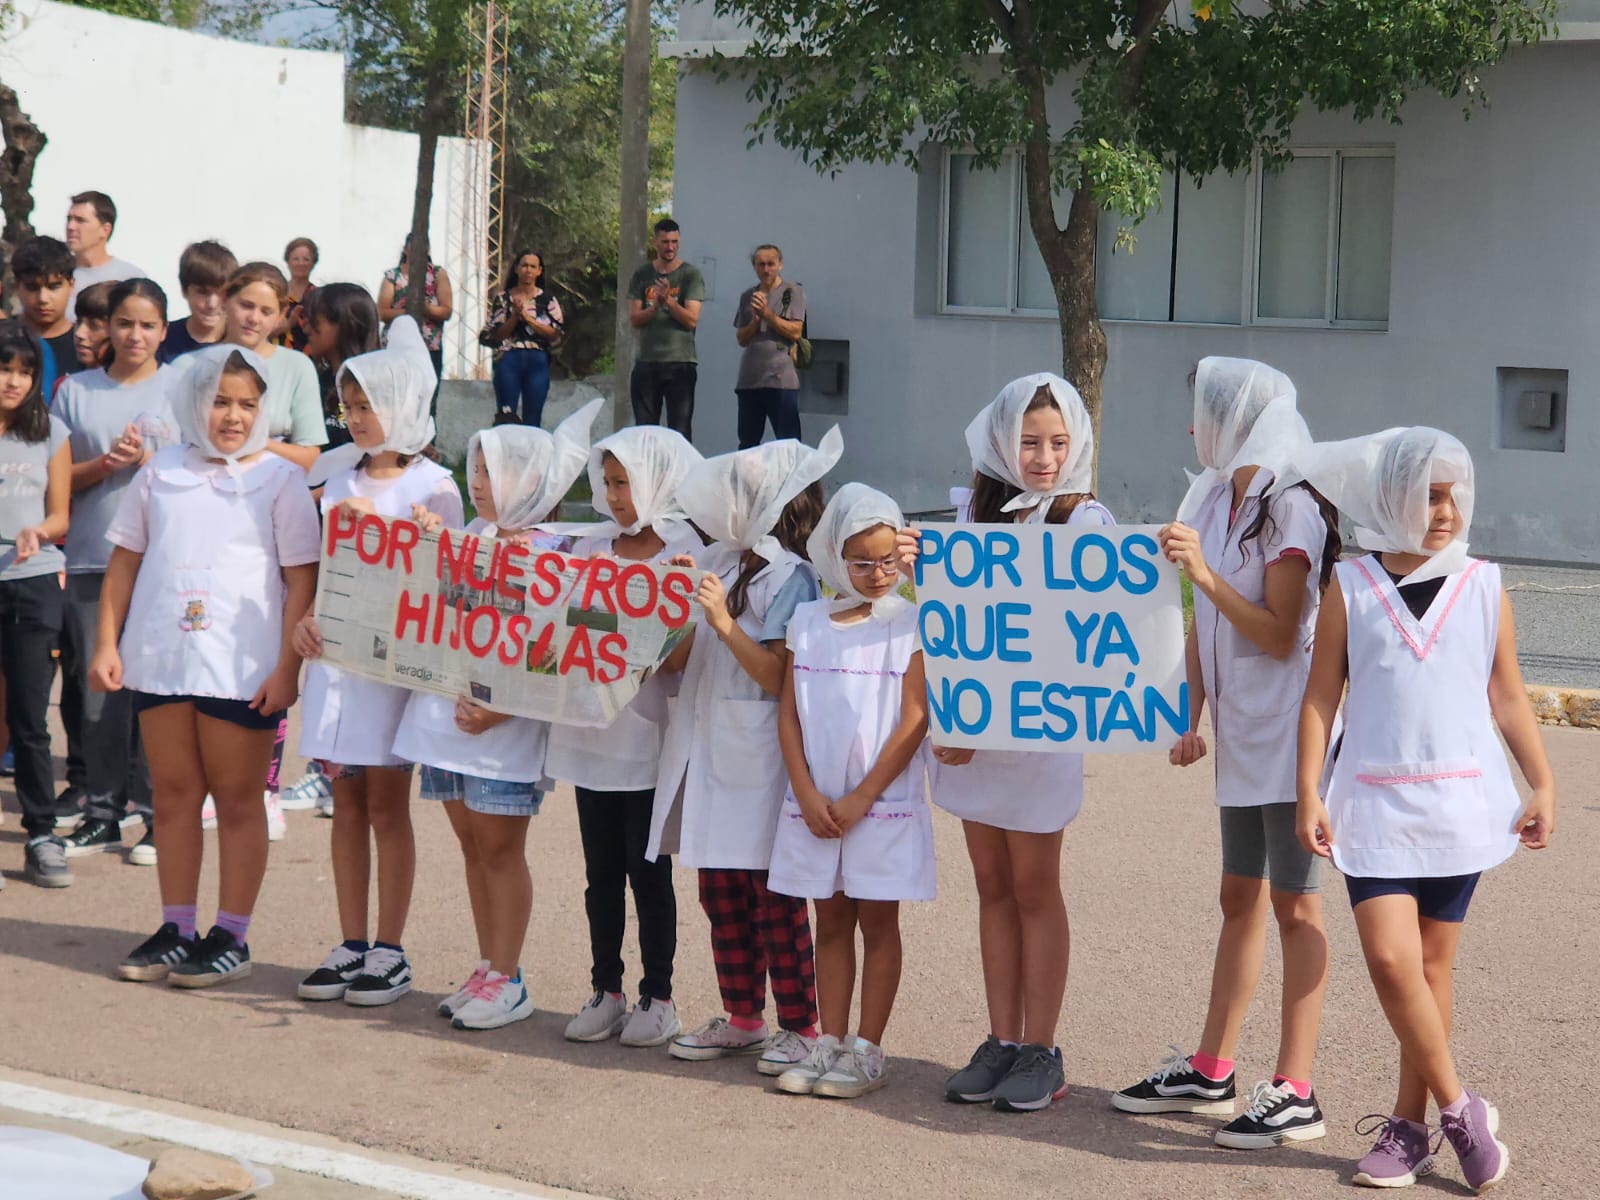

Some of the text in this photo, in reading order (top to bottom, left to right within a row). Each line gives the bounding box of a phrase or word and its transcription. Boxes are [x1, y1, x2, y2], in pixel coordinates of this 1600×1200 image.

[327, 505, 695, 629] POR NUESTROS
[914, 529, 1160, 596] POR LOS
[918, 599, 1141, 668] QUE YA
[926, 671, 1191, 743] NO ESTÁN
